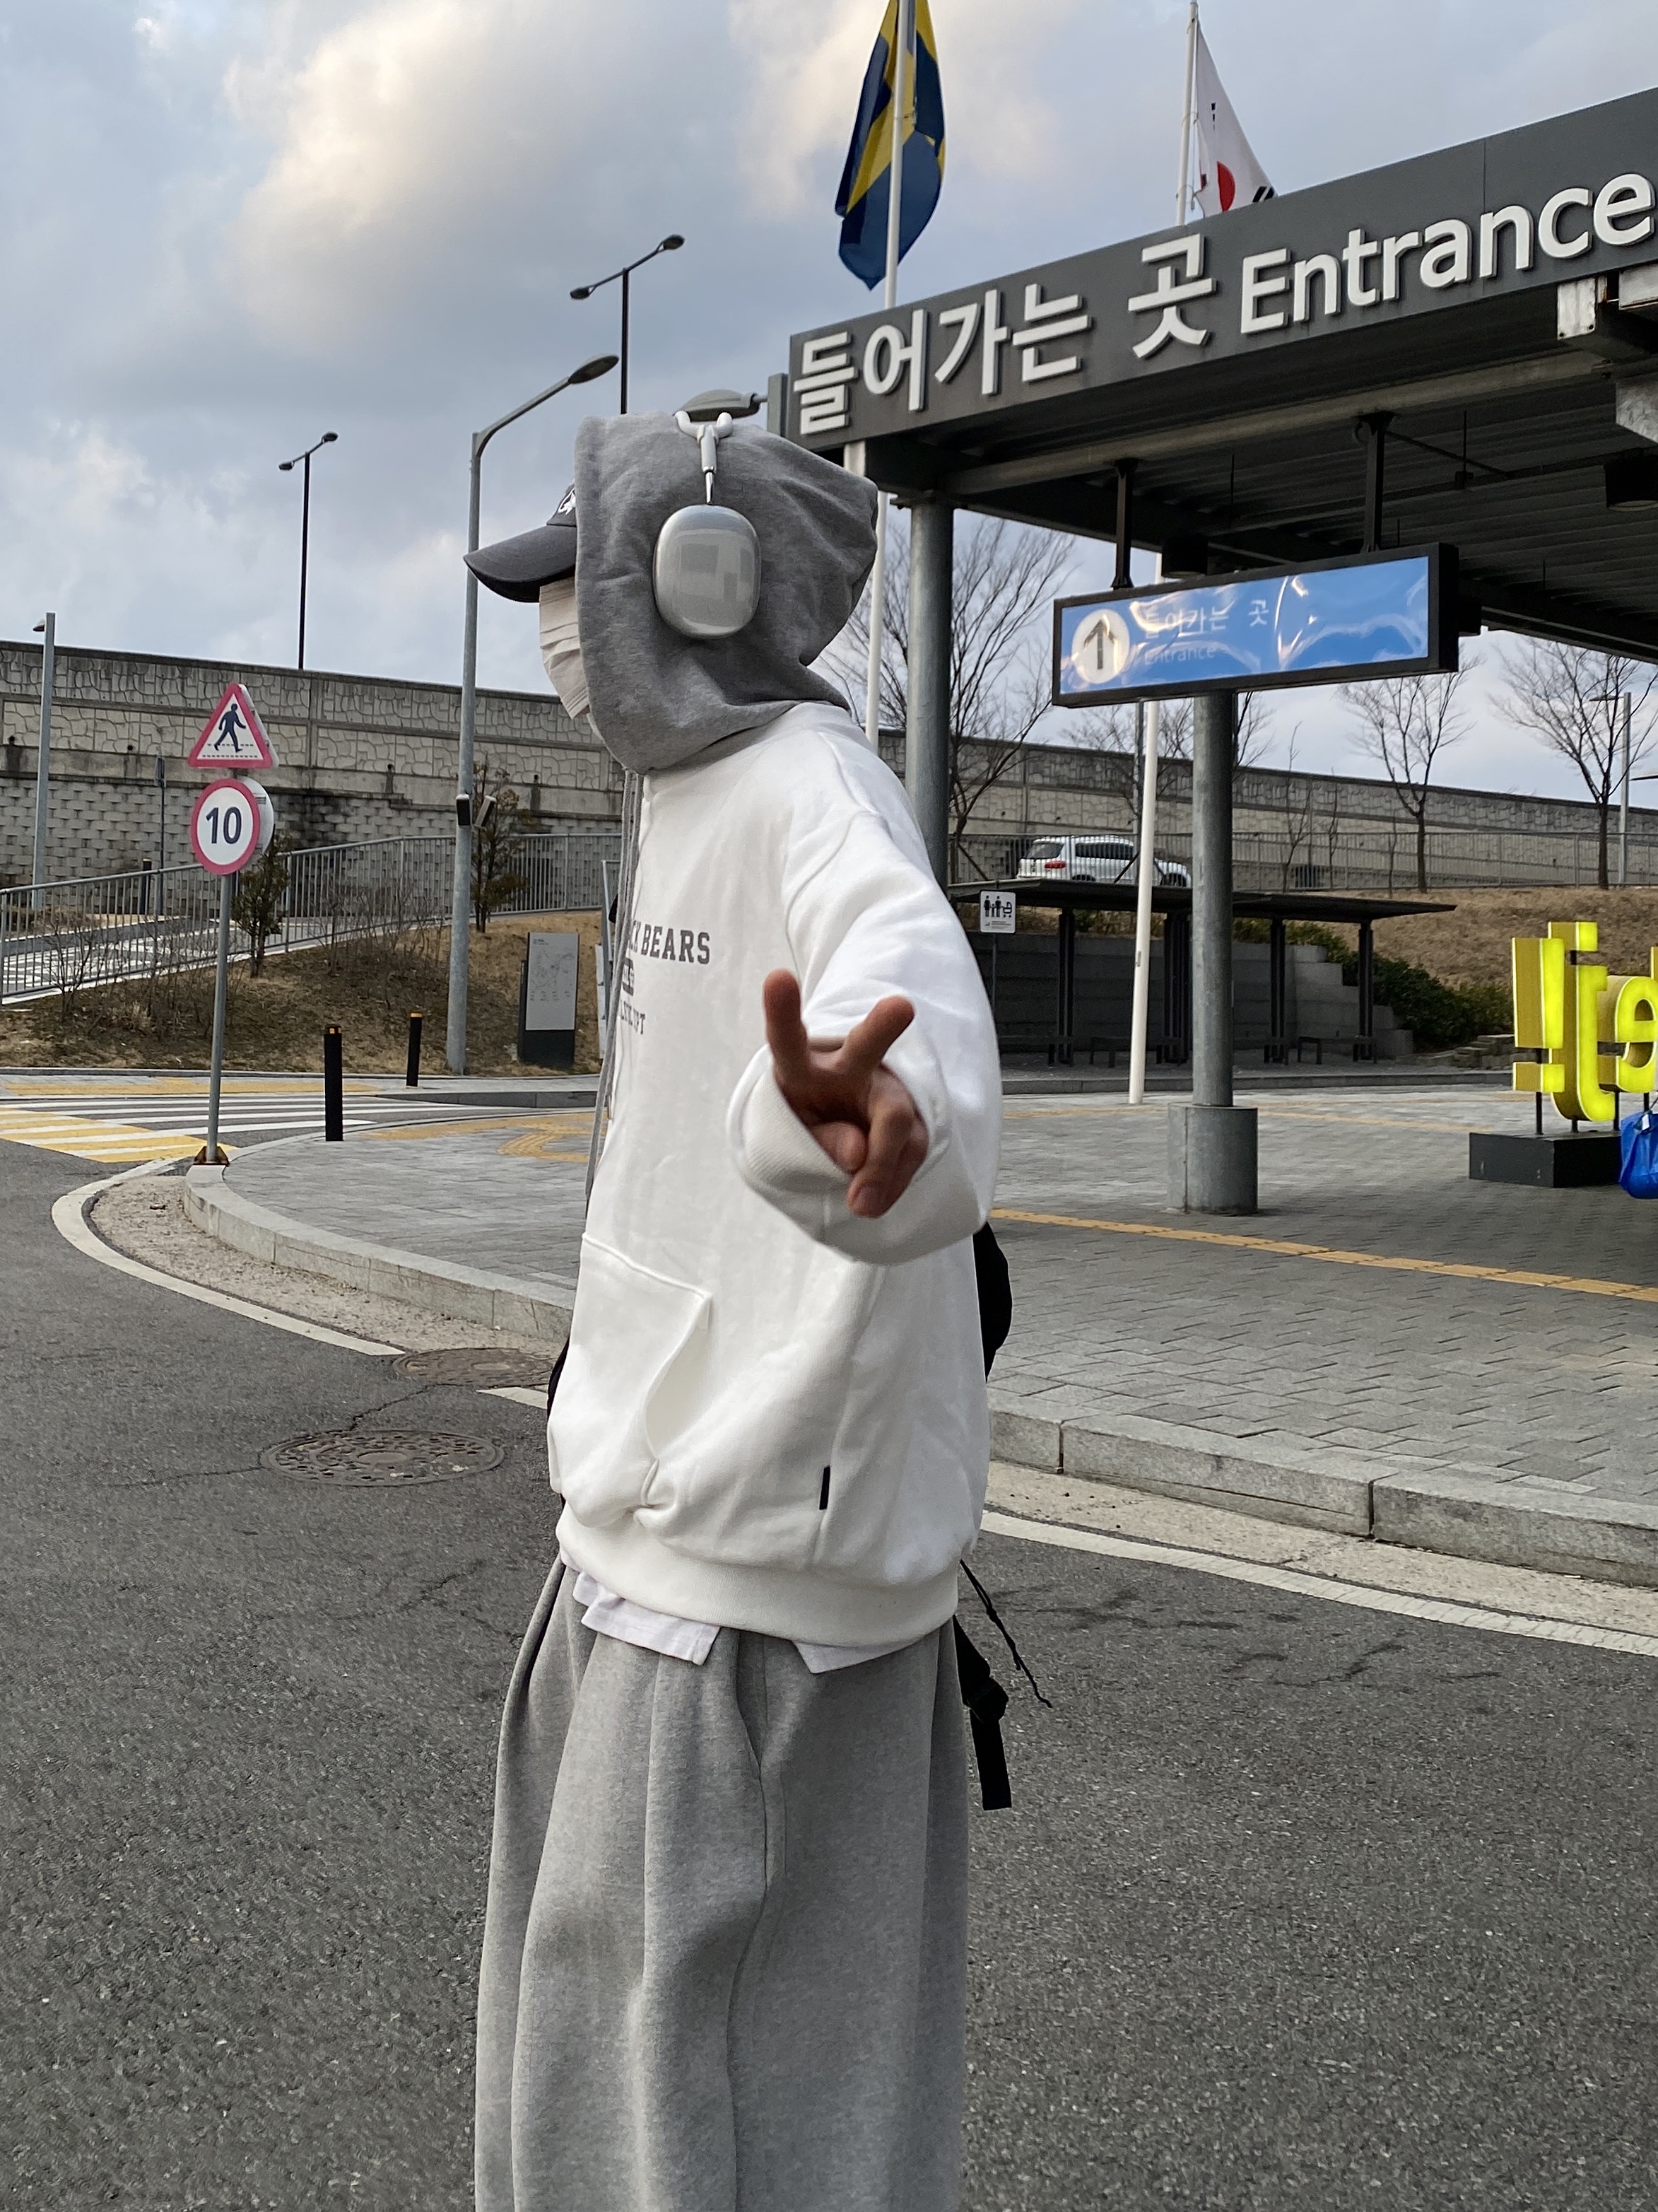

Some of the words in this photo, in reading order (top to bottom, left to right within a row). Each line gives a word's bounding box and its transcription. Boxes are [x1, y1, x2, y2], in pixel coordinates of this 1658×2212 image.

[793, 283, 1091, 437] 들어가는
[1127, 232, 1218, 359] 곳
[1240, 172, 1657, 336] Entrance
[1248, 599, 1269, 627] 곳
[206, 805, 242, 845] 10
[640, 923, 710, 965] BEARS
